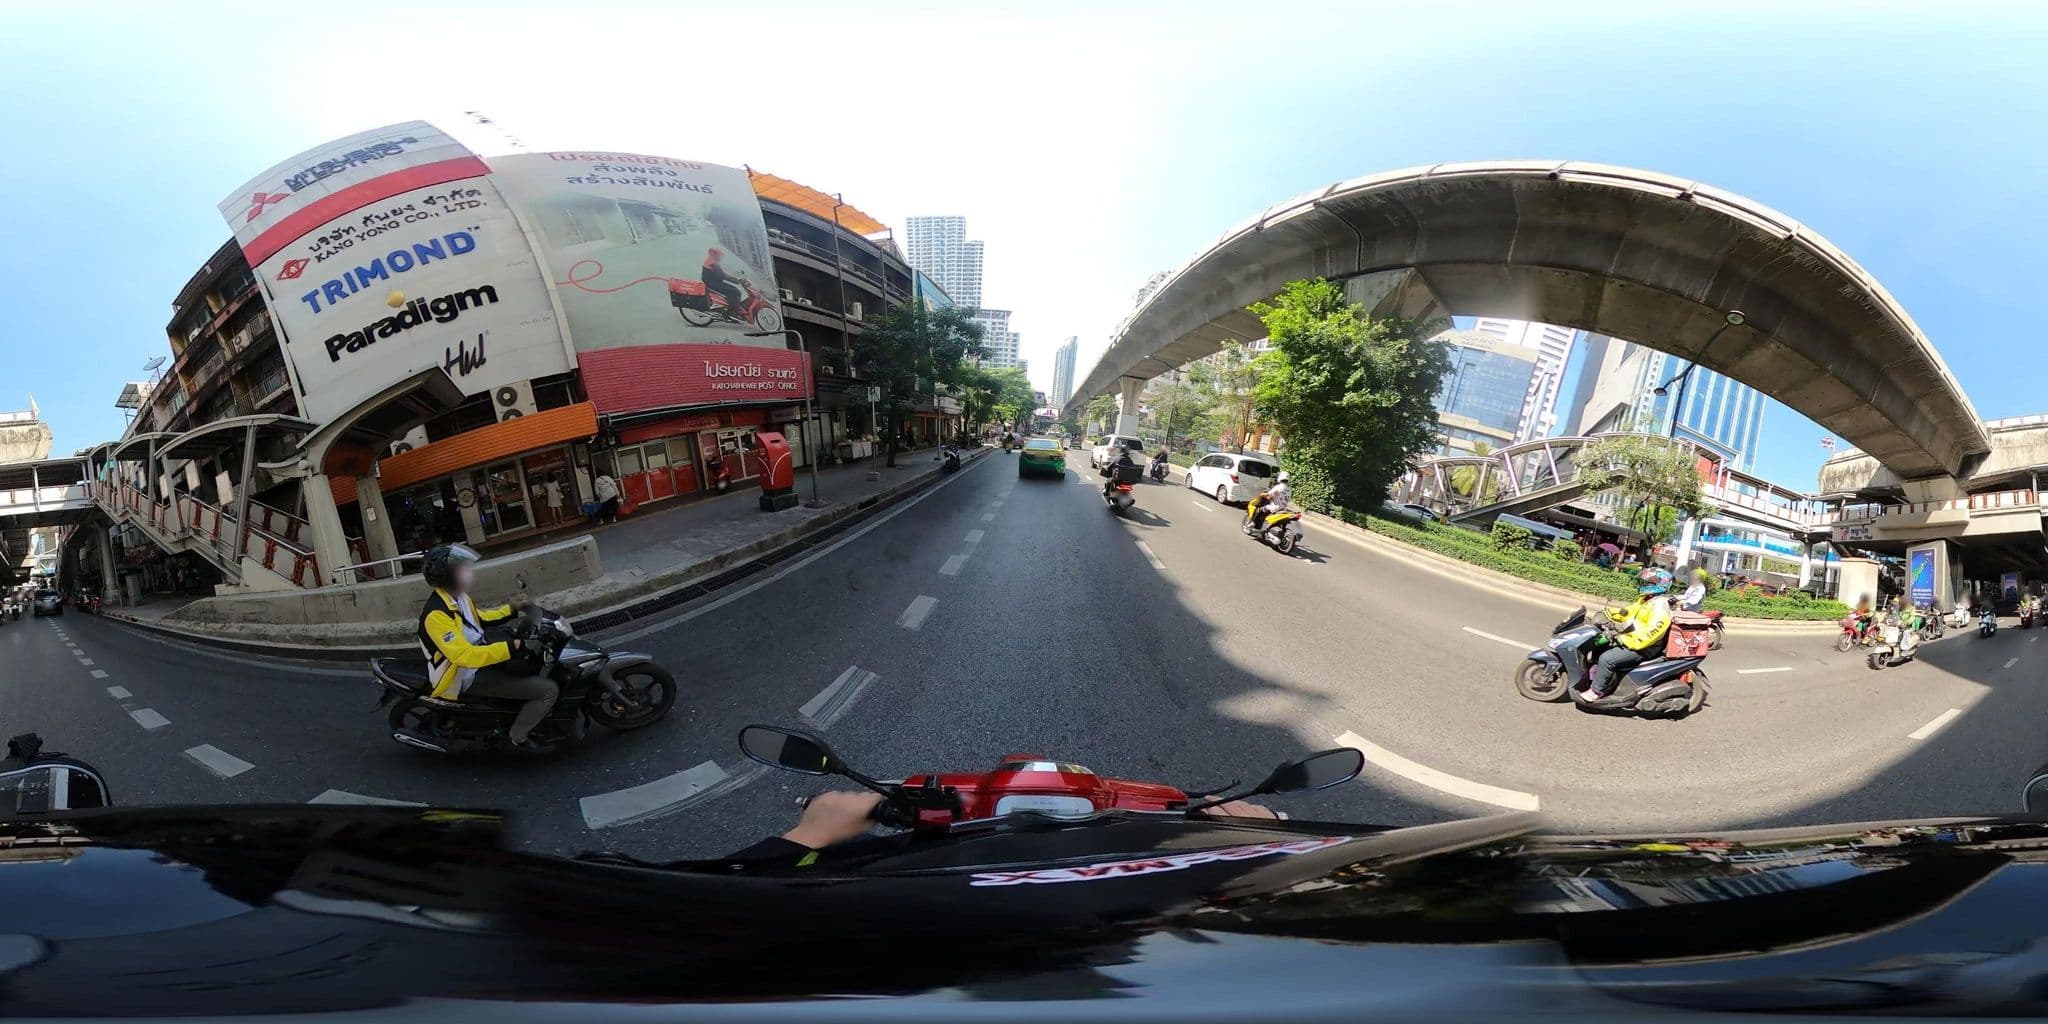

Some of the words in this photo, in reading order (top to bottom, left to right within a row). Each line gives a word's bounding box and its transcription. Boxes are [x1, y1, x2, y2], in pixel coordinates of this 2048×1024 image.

[284, 136, 418, 187] MITSUBISHI
[290, 146, 405, 192] ELECTRIC
[308, 223, 357, 253] บริษัท
[362, 203, 416, 228] กันยง
[423, 188, 483, 206] จำกัด
[315, 239, 354, 264] KANG
[356, 220, 400, 242] YONG
[405, 210, 440, 224] CO.,
[443, 199, 488, 214] LTD.
[302, 231, 476, 314] TRIMOND
[325, 283, 500, 363] Paradigm
[703, 360, 762, 378] ไปรษณีย์
[758, 382, 775, 390] POST
[778, 382, 797, 390] OFFICE
